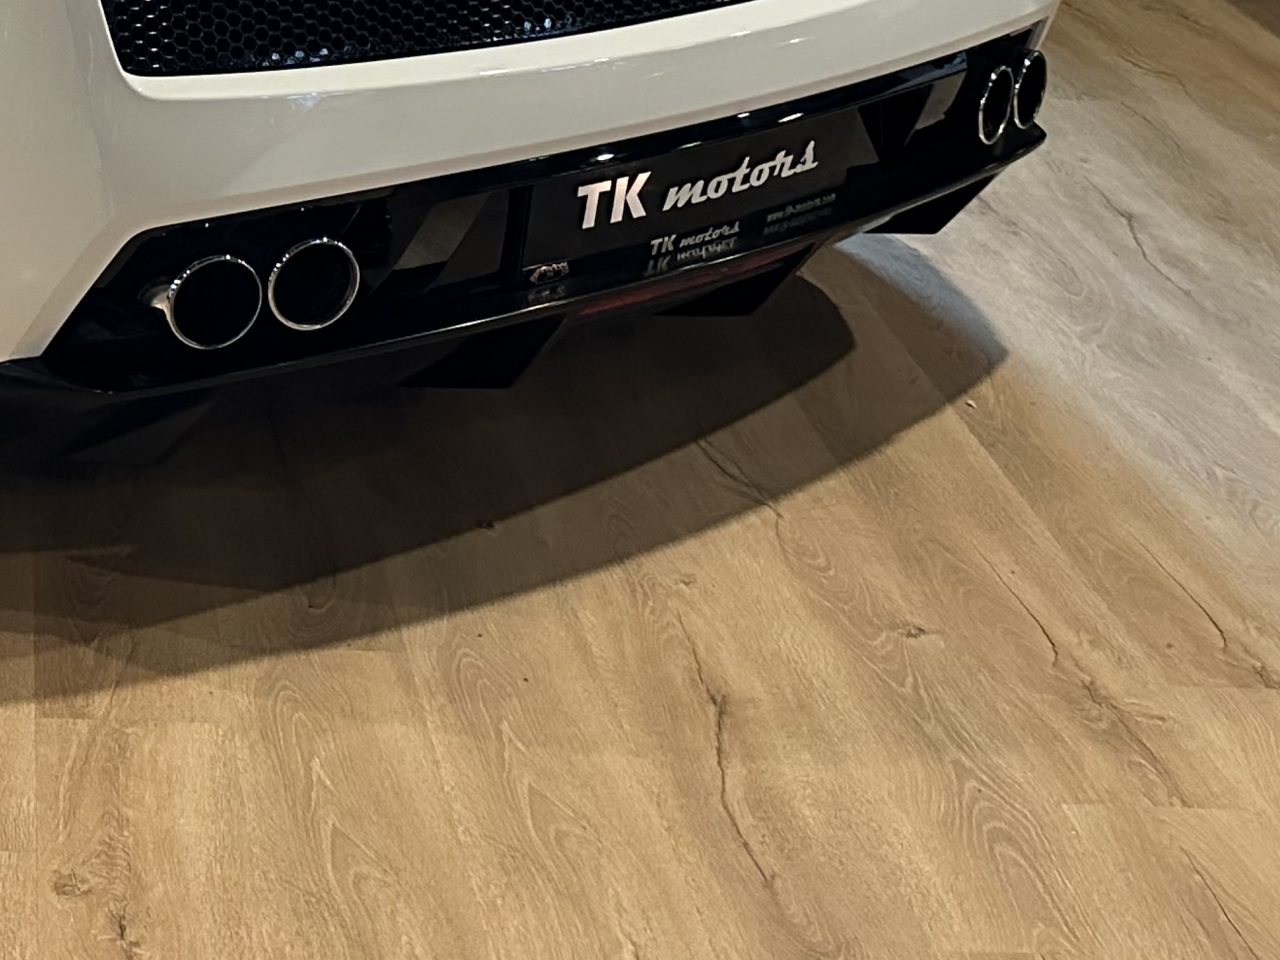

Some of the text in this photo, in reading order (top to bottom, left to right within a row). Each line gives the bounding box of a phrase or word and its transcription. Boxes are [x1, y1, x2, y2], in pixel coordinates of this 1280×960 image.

[576, 171, 653, 229] TK
[662, 141, 819, 211] motors
[650, 221, 740, 255] TK motors
